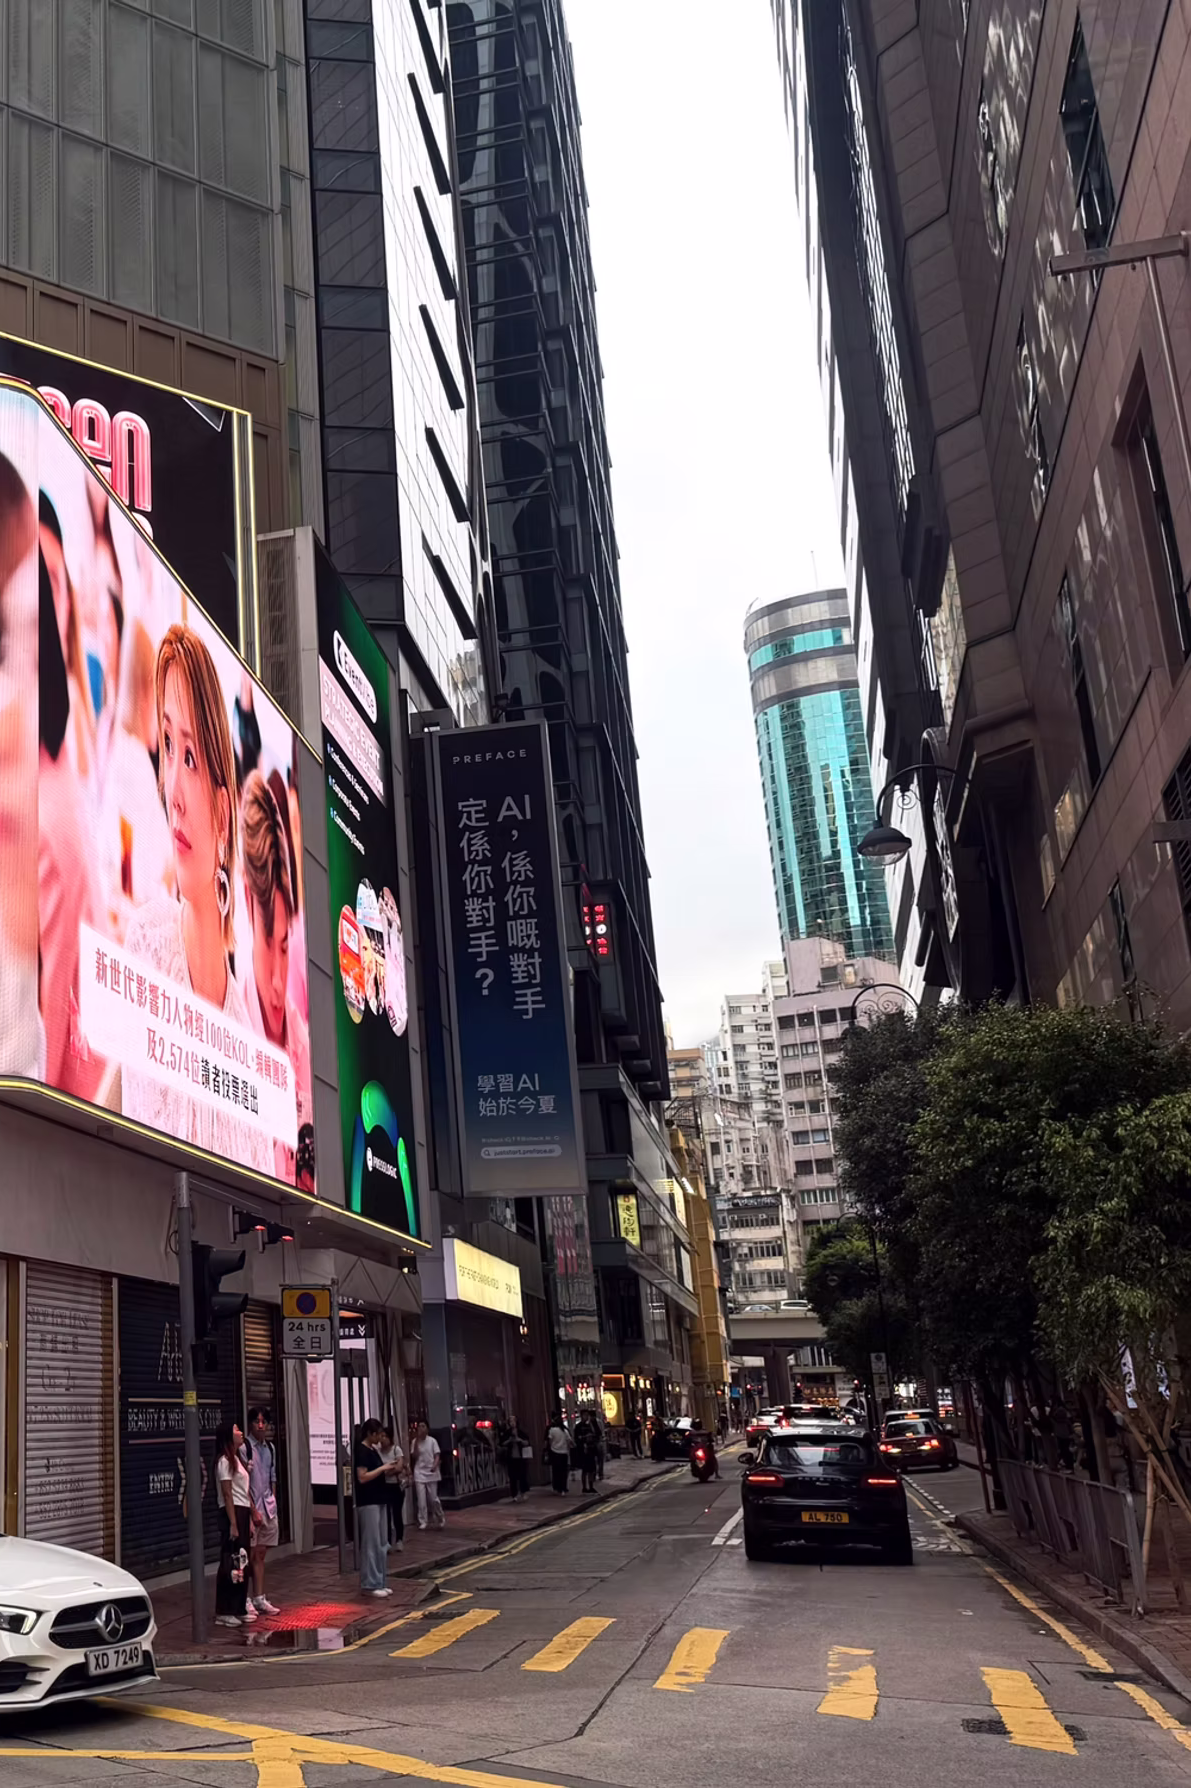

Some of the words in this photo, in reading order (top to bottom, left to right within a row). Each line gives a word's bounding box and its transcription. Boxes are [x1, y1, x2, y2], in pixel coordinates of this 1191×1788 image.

[452, 748, 527, 765] PREFACE
[478, 1095, 557, 1117] 始於今夏
[288, 1321, 304, 1332] 24
[307, 1321, 326, 1332] hrs
[292, 1335, 322, 1350] 全日
[127, 1408, 159, 1431] BEAUTY
[808, 1513, 821, 1522] AL
[94, 1652, 110, 1671] XD
[113, 1646, 139, 1668] 7249
